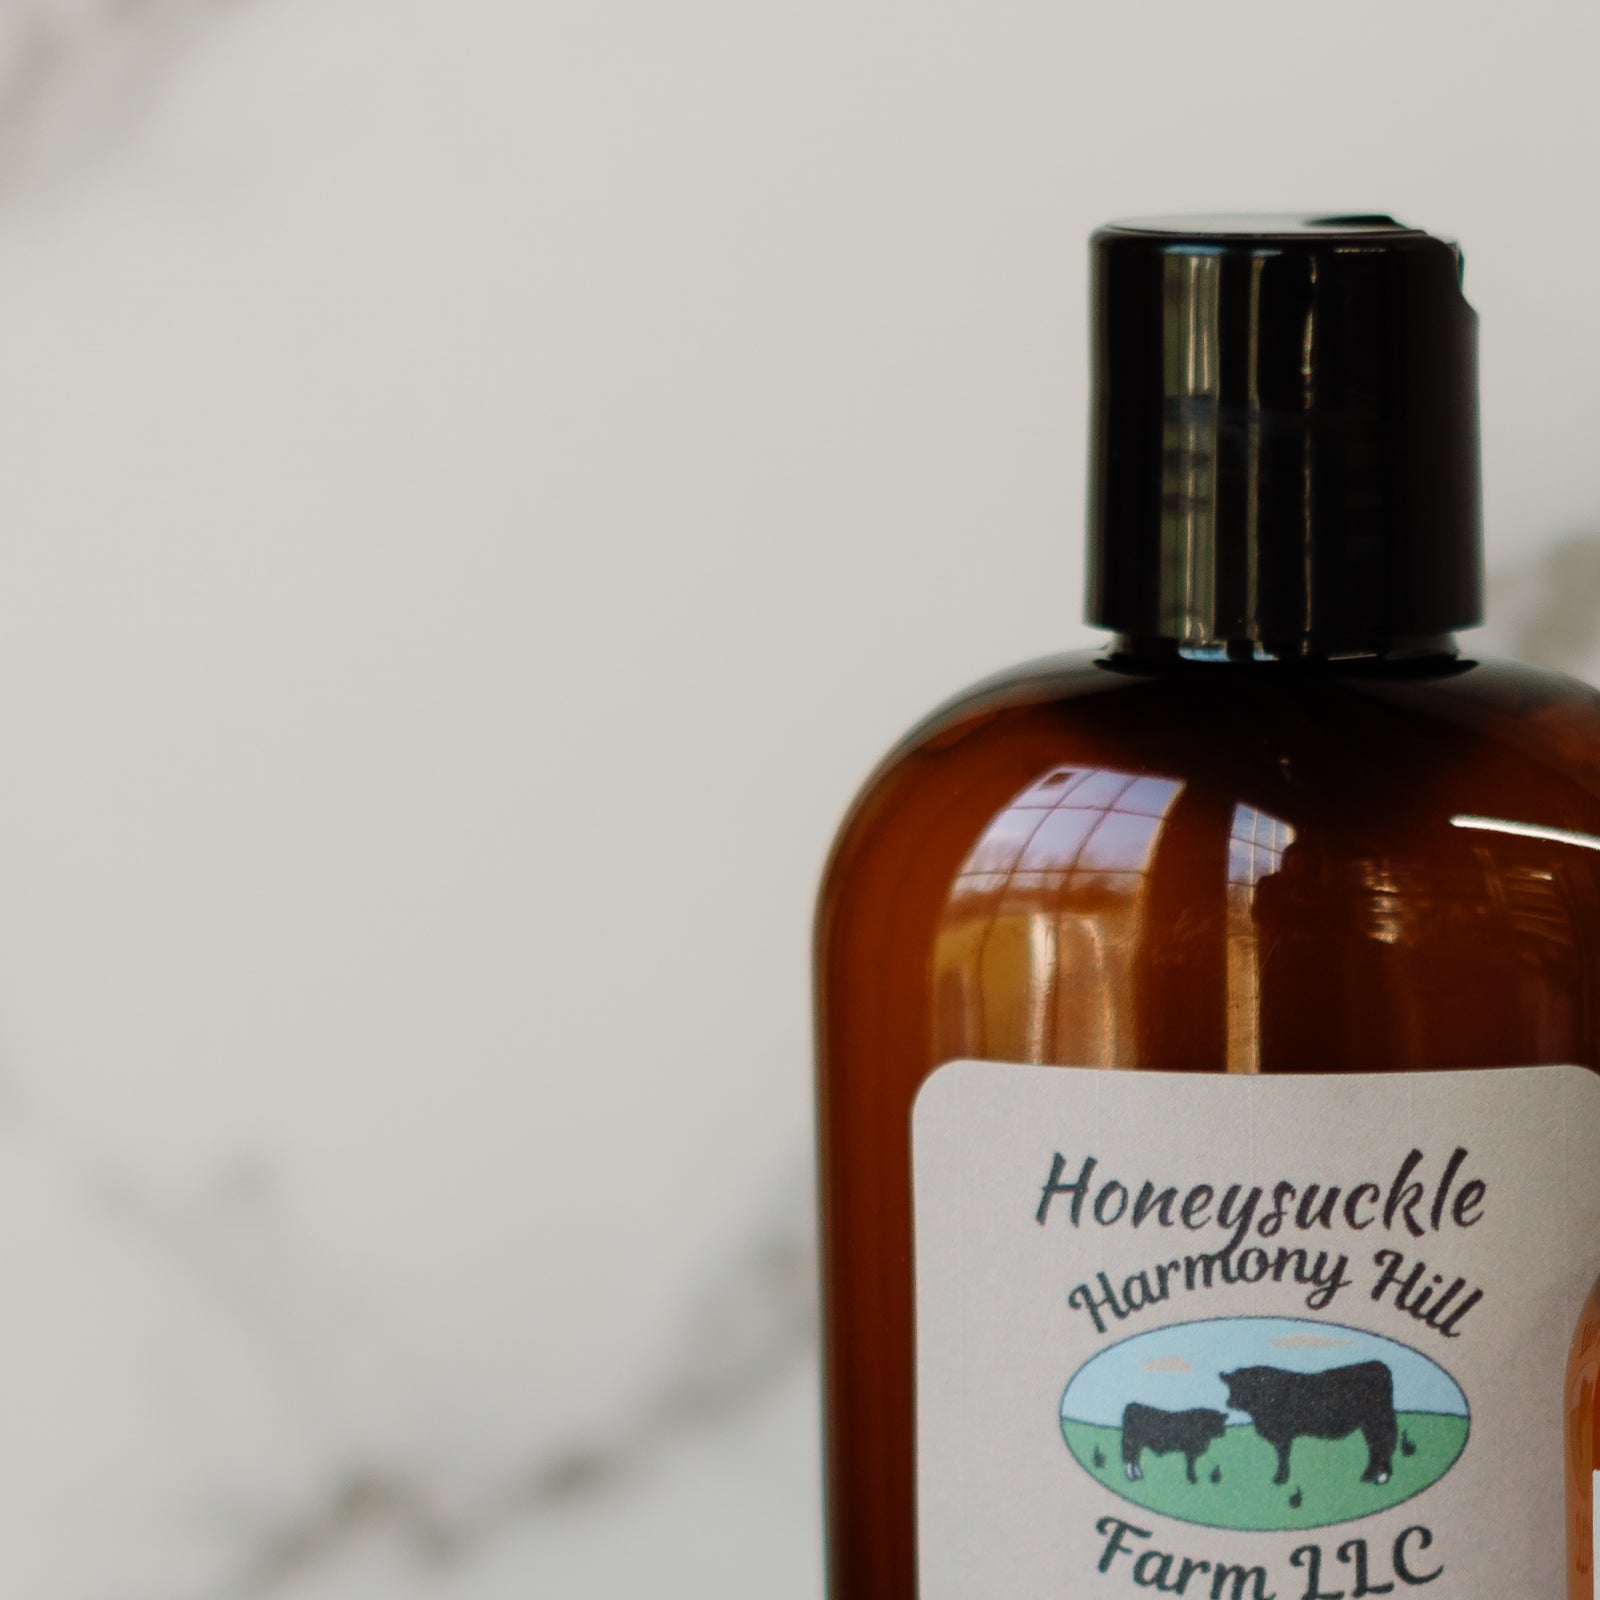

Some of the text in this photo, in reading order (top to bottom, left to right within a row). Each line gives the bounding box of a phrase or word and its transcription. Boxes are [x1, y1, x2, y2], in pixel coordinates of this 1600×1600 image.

[1035, 1147, 1486, 1255] Honeysuckle
[1069, 1243, 1484, 1339] Harmony Hill
